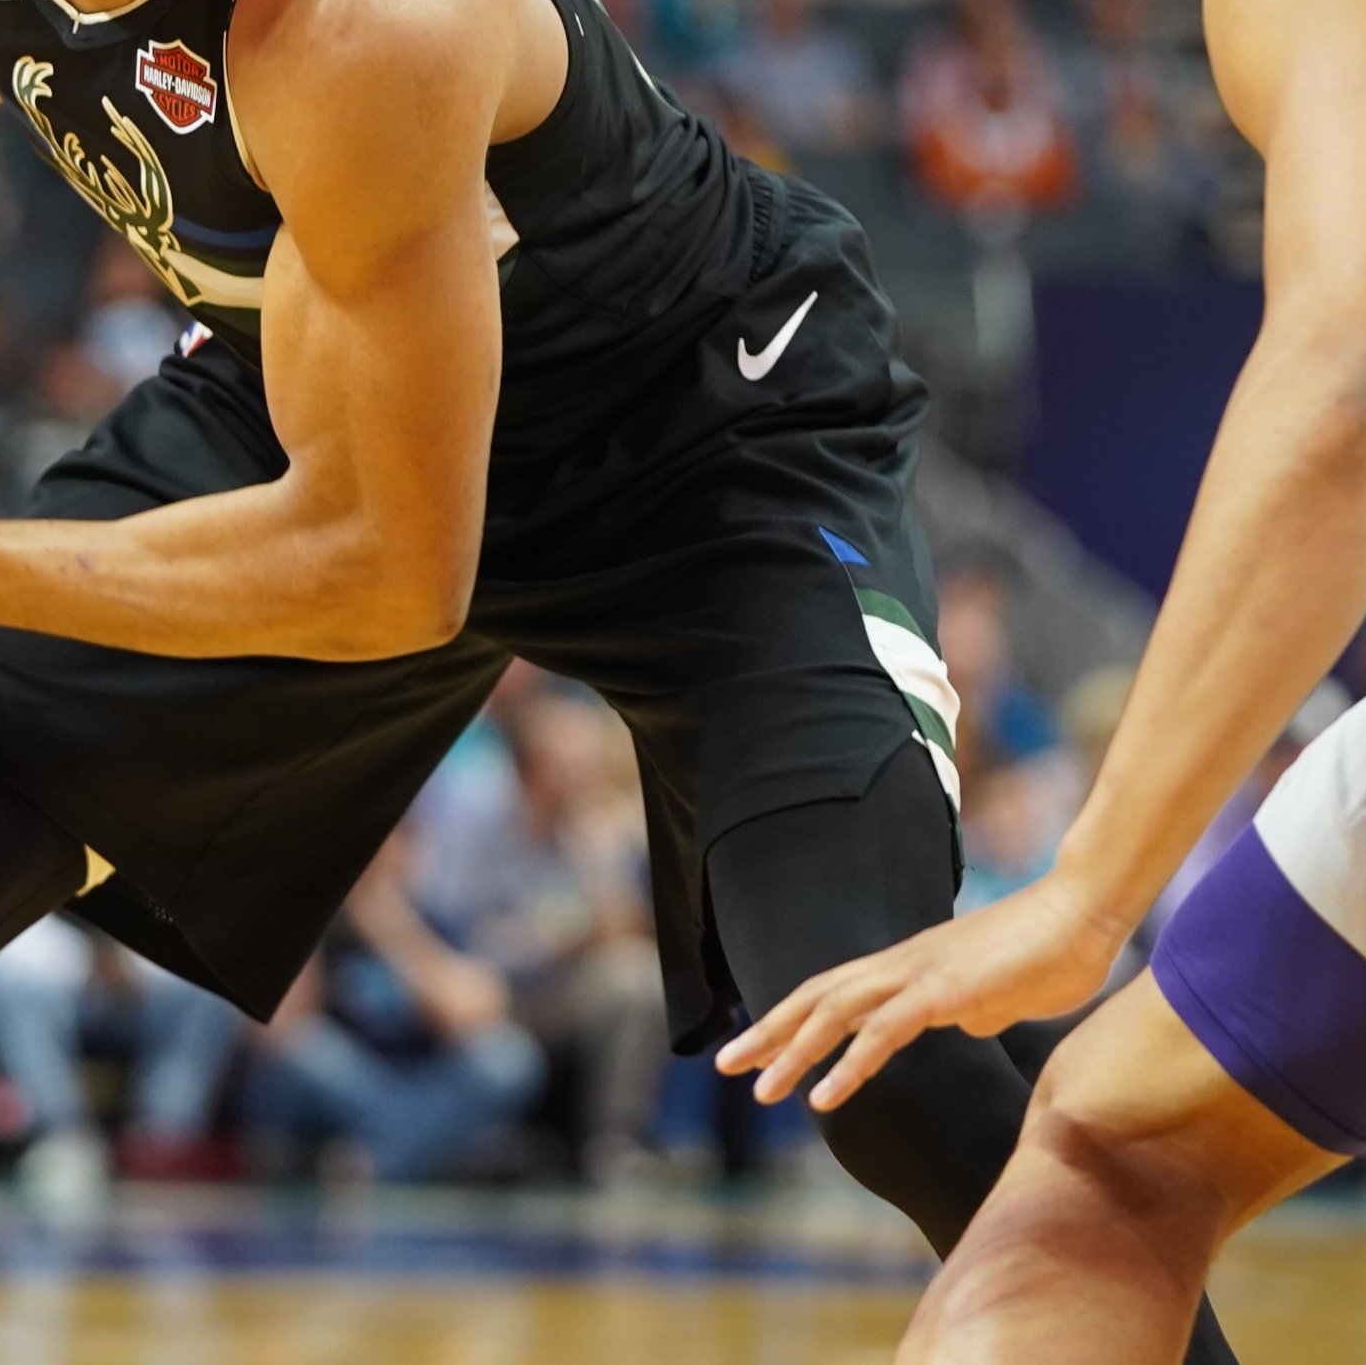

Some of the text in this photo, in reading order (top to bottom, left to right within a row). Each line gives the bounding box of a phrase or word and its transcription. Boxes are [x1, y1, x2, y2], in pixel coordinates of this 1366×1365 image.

[159, 54, 199, 77] MOTOR
[143, 63, 213, 110] HARLEY-DAVIDSON
[158, 93, 197, 122] CYCLES
